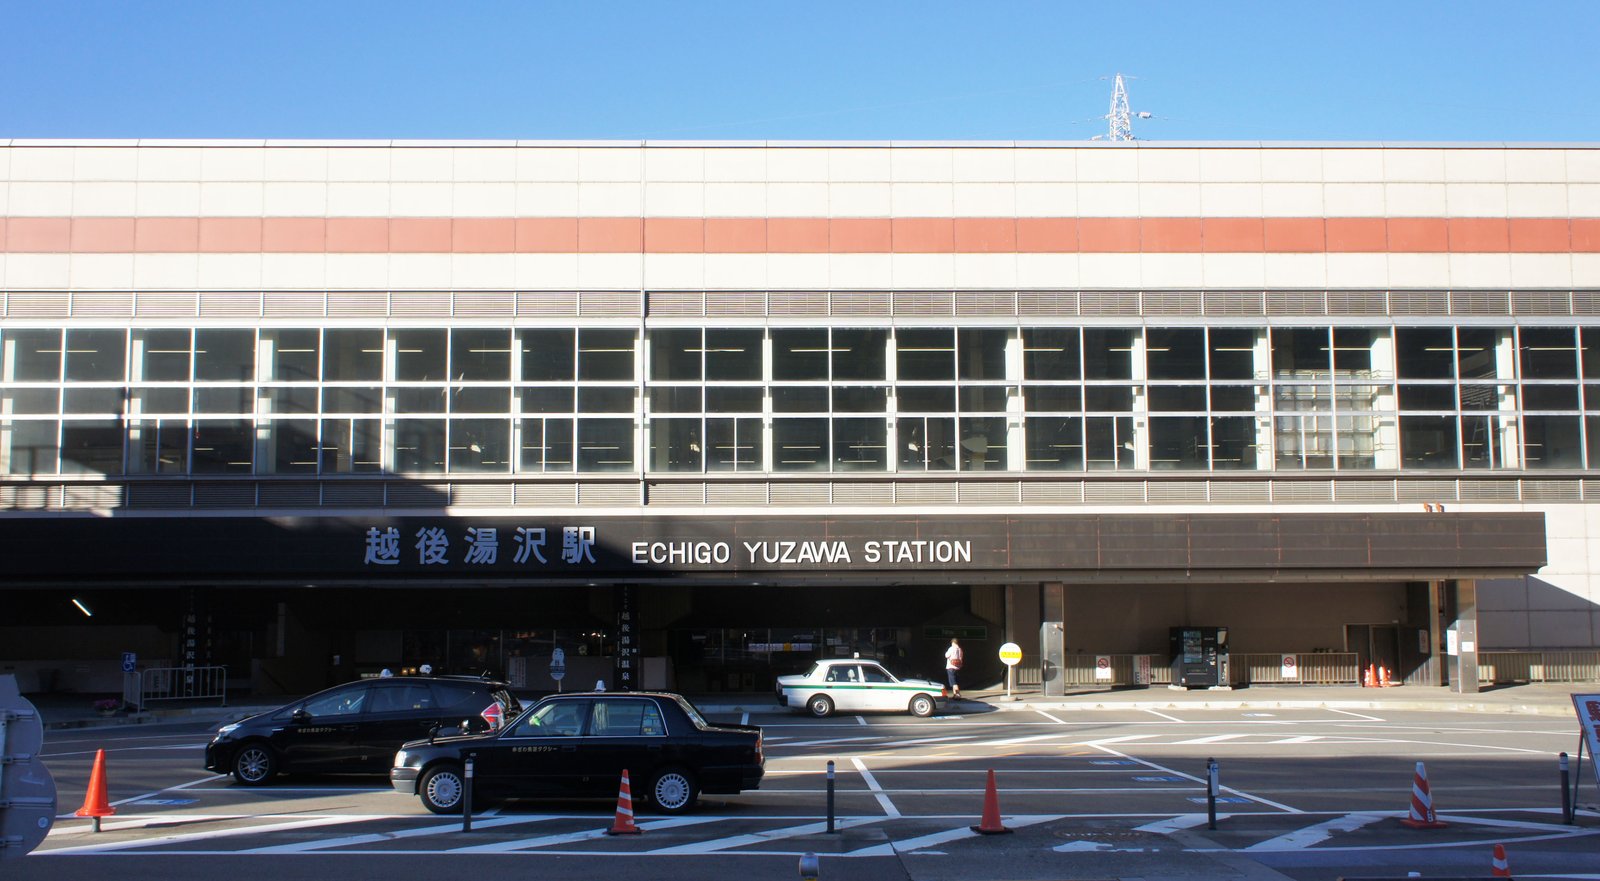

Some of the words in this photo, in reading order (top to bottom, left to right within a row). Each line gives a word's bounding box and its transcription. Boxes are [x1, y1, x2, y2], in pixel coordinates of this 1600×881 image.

[364, 526, 597, 565] 越後湯沢駅
[631, 541, 731, 564] ECHIGO
[743, 541, 852, 564] YUZAWA
[864, 540, 973, 563] STATION
